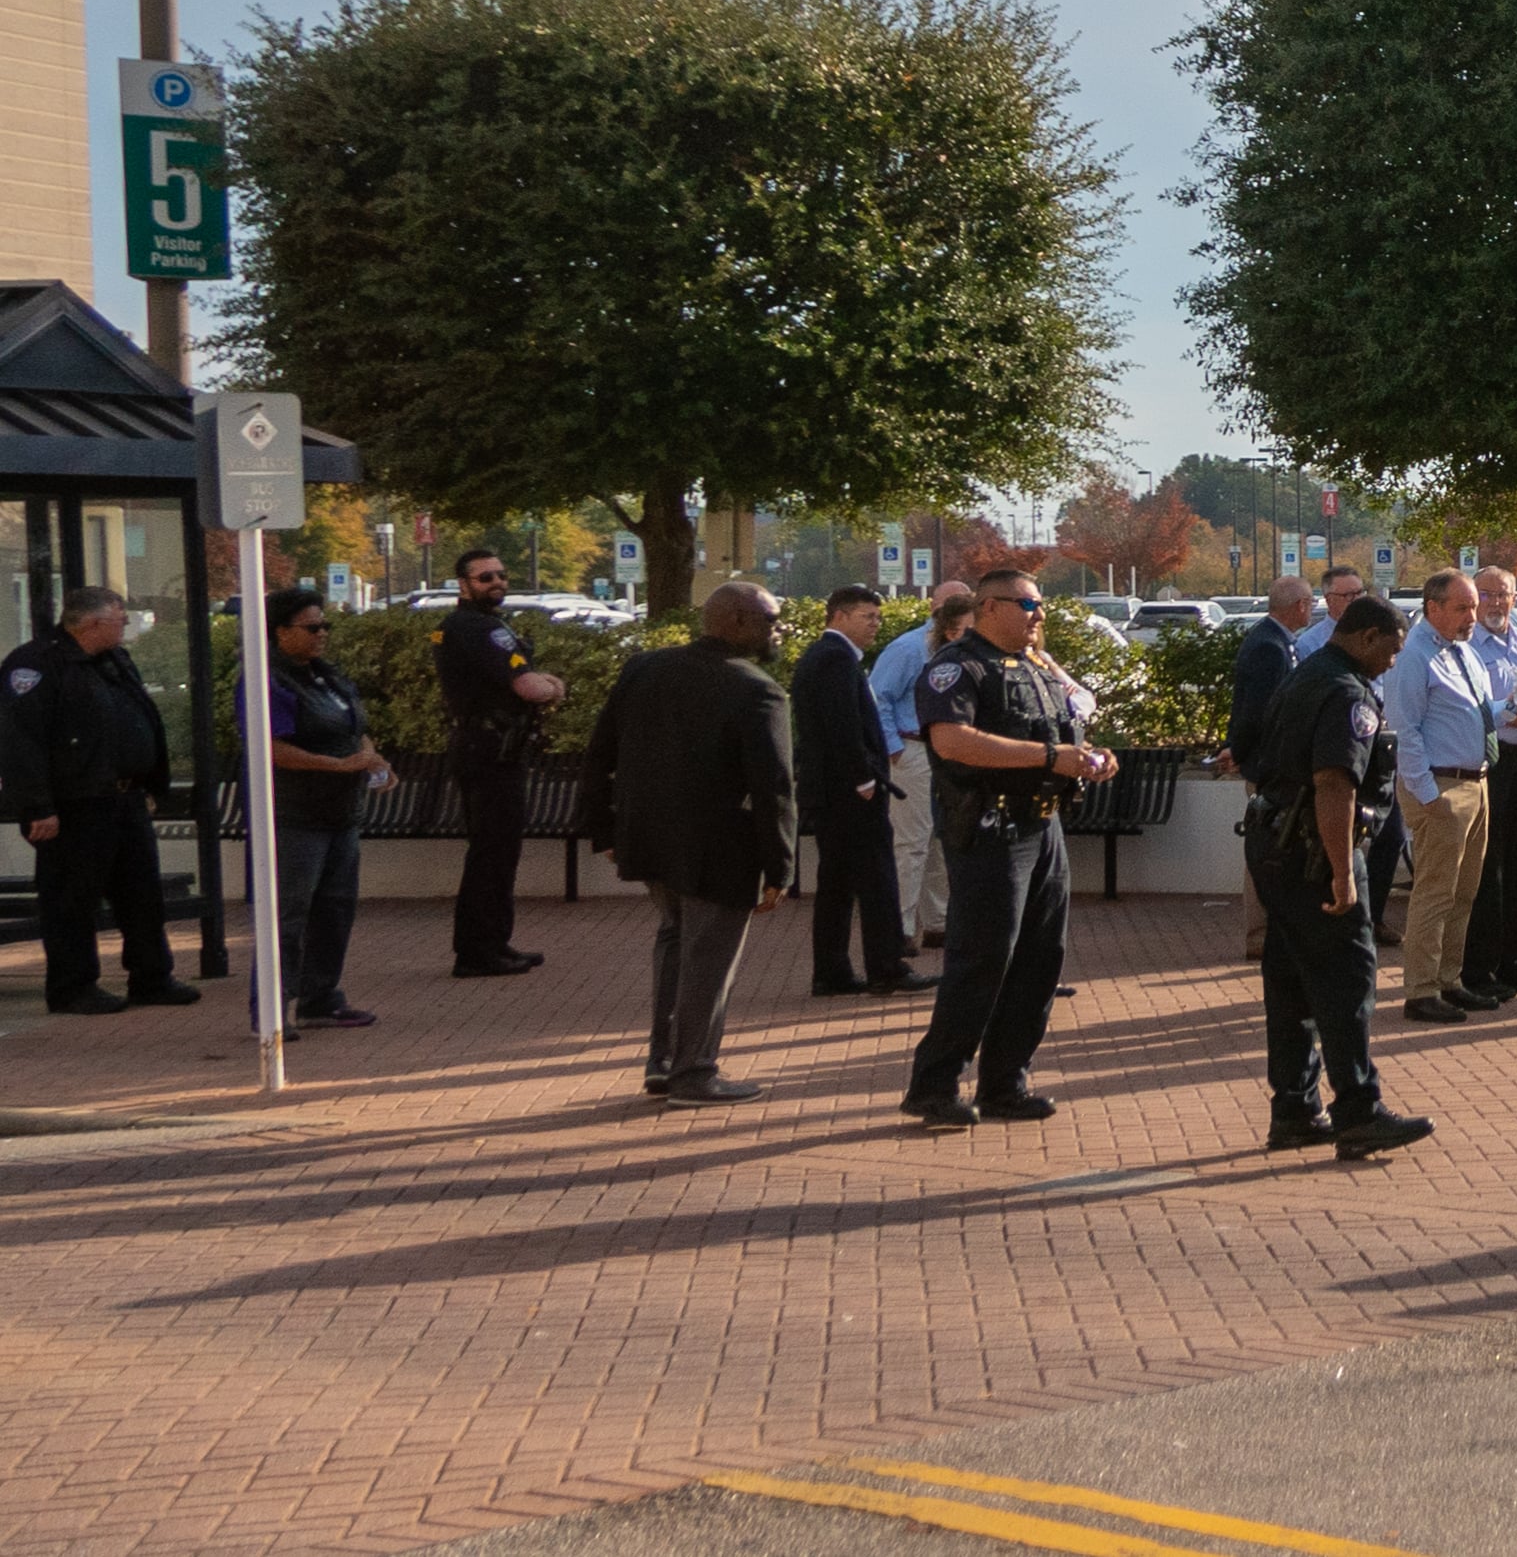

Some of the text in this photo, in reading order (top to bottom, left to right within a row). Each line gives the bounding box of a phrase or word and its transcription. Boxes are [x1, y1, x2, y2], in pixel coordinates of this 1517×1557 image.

[163, 78, 185, 102] P
[151, 130, 202, 231] 5
[154, 235, 202, 252] Visitor
[151, 252, 207, 272] Parking
[1326, 493, 1335, 509] 4
